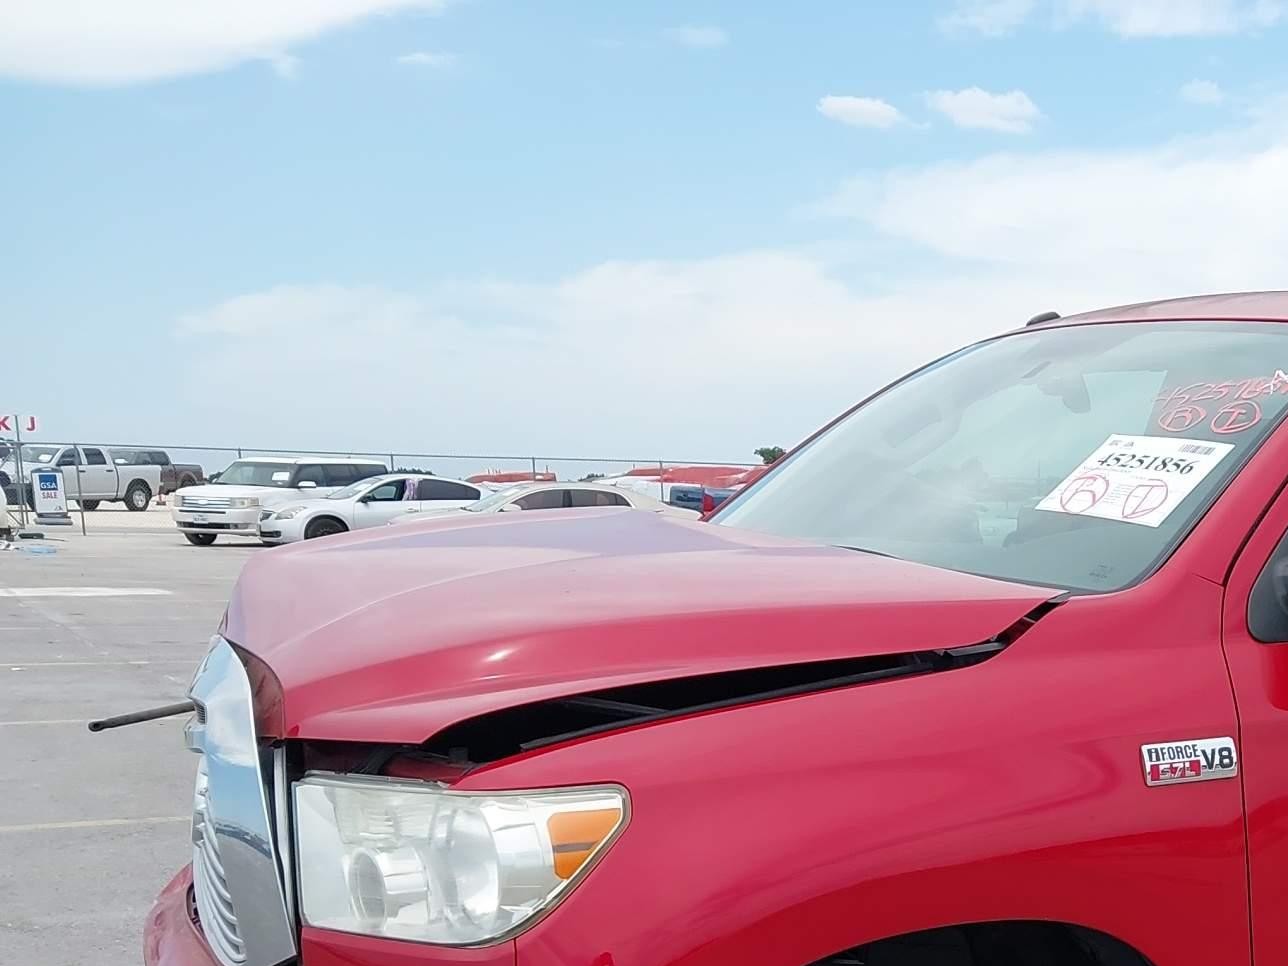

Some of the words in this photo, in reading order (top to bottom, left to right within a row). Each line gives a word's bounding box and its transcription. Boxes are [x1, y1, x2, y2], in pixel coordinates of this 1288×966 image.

[0, 416, 11, 431] K
[26, 416, 36, 431] J
[1097, 452, 1199, 475] 45251856
[42, 491, 58, 499] SALE
[1200, 746, 1234, 770] V8
[1160, 762, 1197, 778] 5.7L
